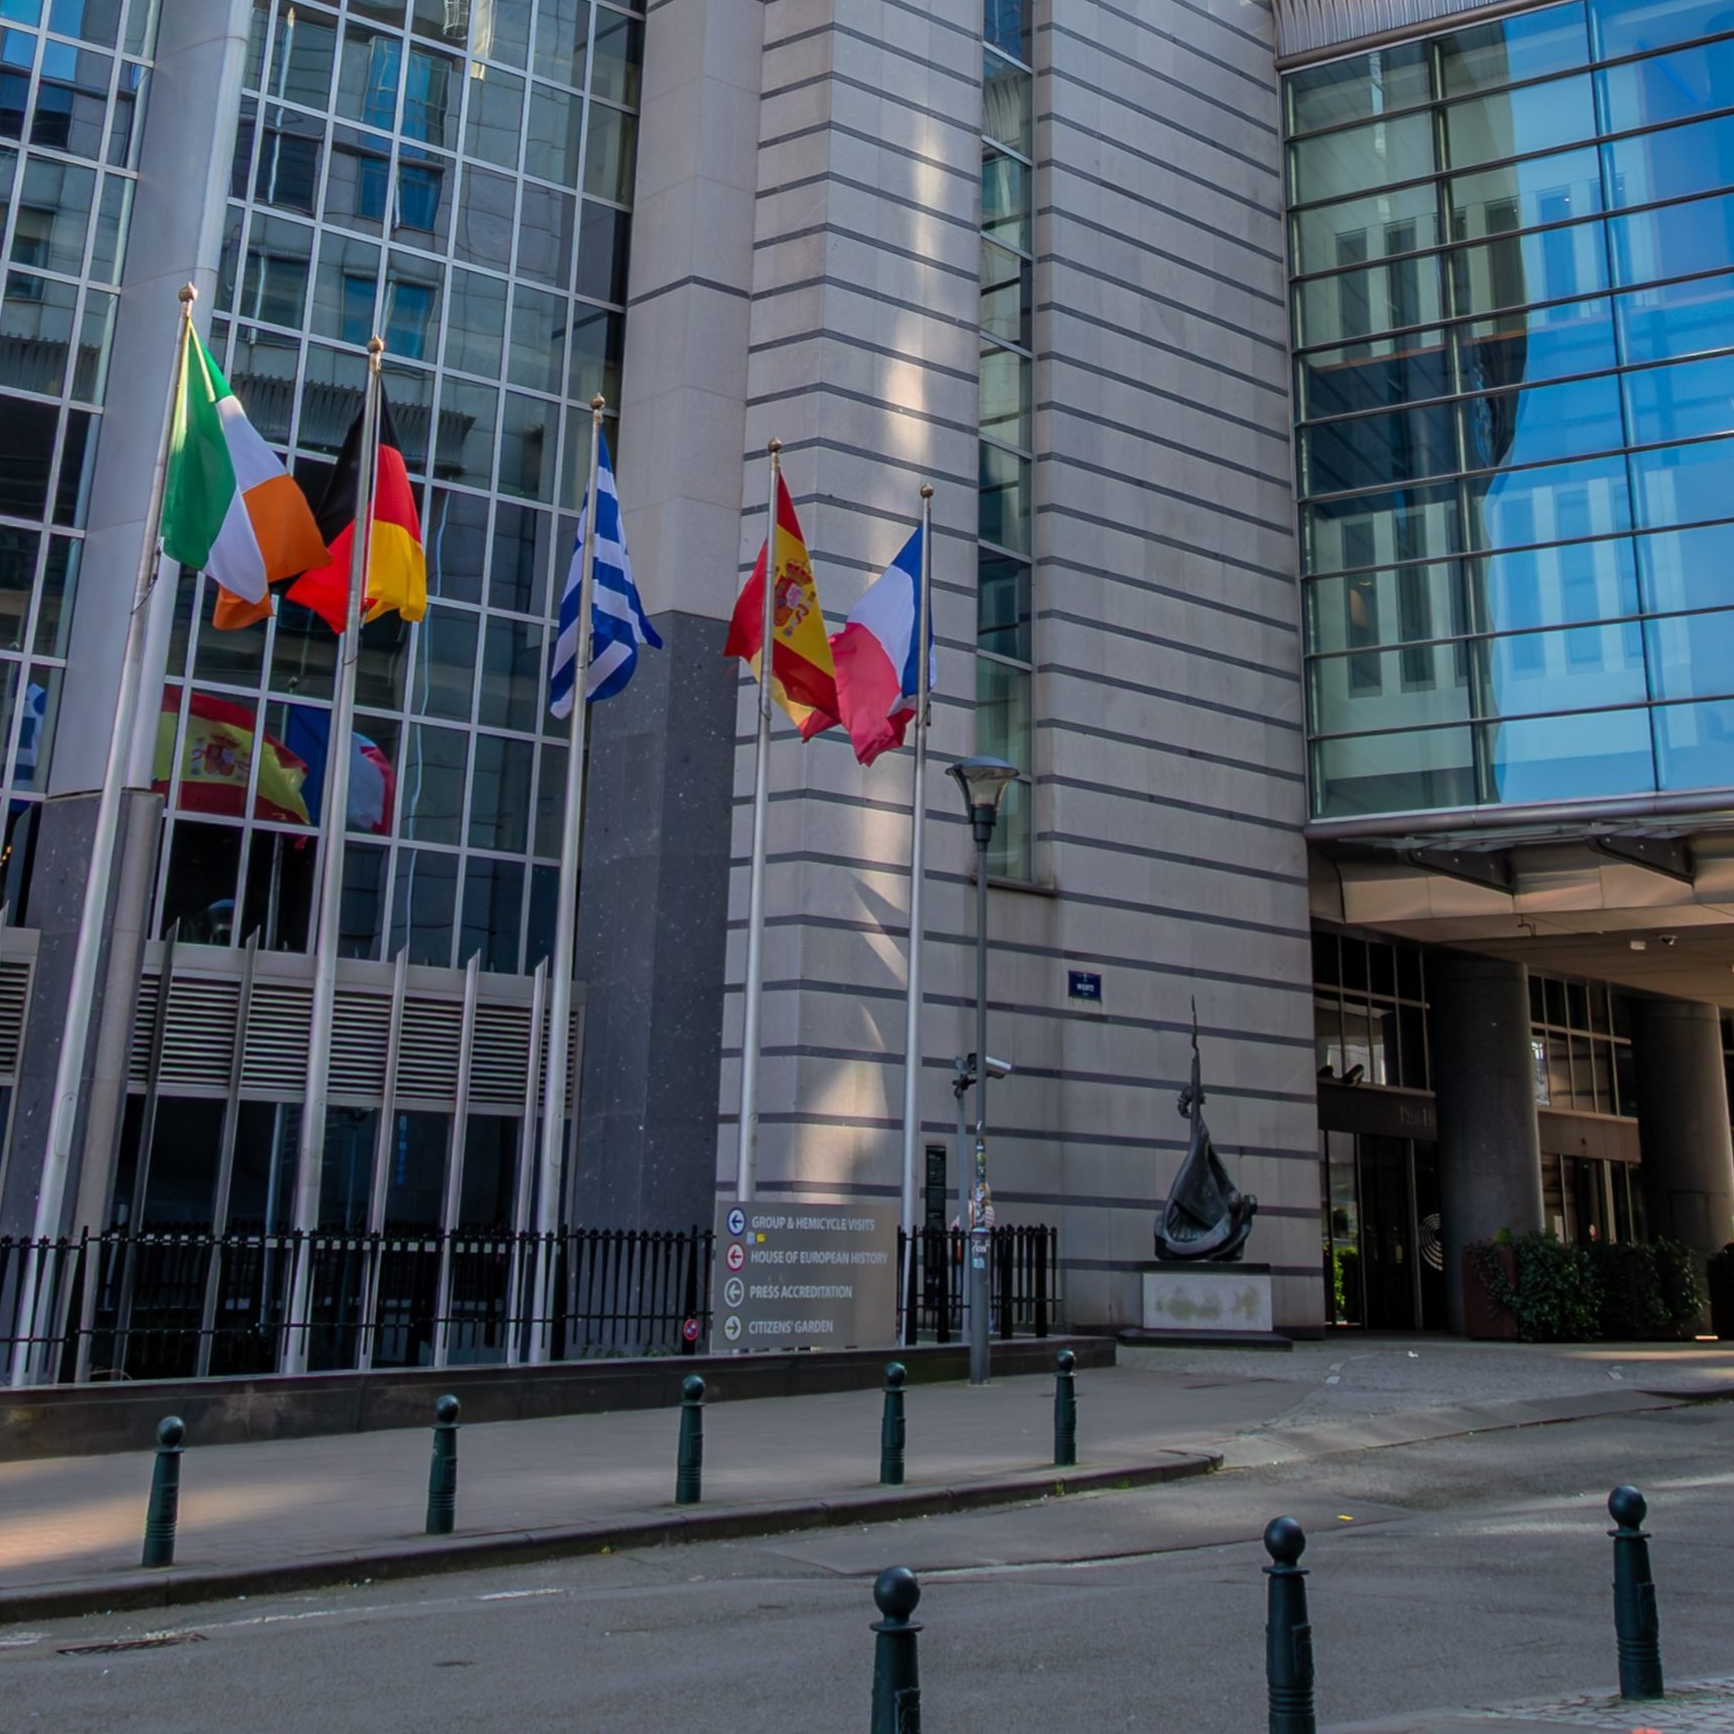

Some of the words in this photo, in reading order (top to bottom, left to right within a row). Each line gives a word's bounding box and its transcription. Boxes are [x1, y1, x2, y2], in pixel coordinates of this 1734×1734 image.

[752, 1216, 785, 1229] GROUP
[787, 1217, 794, 1229] &
[796, 1217, 847, 1231] HEMICYCLE
[848, 1218, 875, 1231] VISITS
[750, 1251, 784, 1264] HOUSE
[786, 1251, 798, 1264] OF
[800, 1251, 849, 1264] EUROPEAN
[850, 1252, 888, 1265] HISTORY
[750, 1285, 779, 1299] PRESS
[781, 1285, 853, 1299] ACCREDITATION
[748, 1320, 794, 1334] CITIZENS'
[794, 1320, 834, 1333] GARDEN
